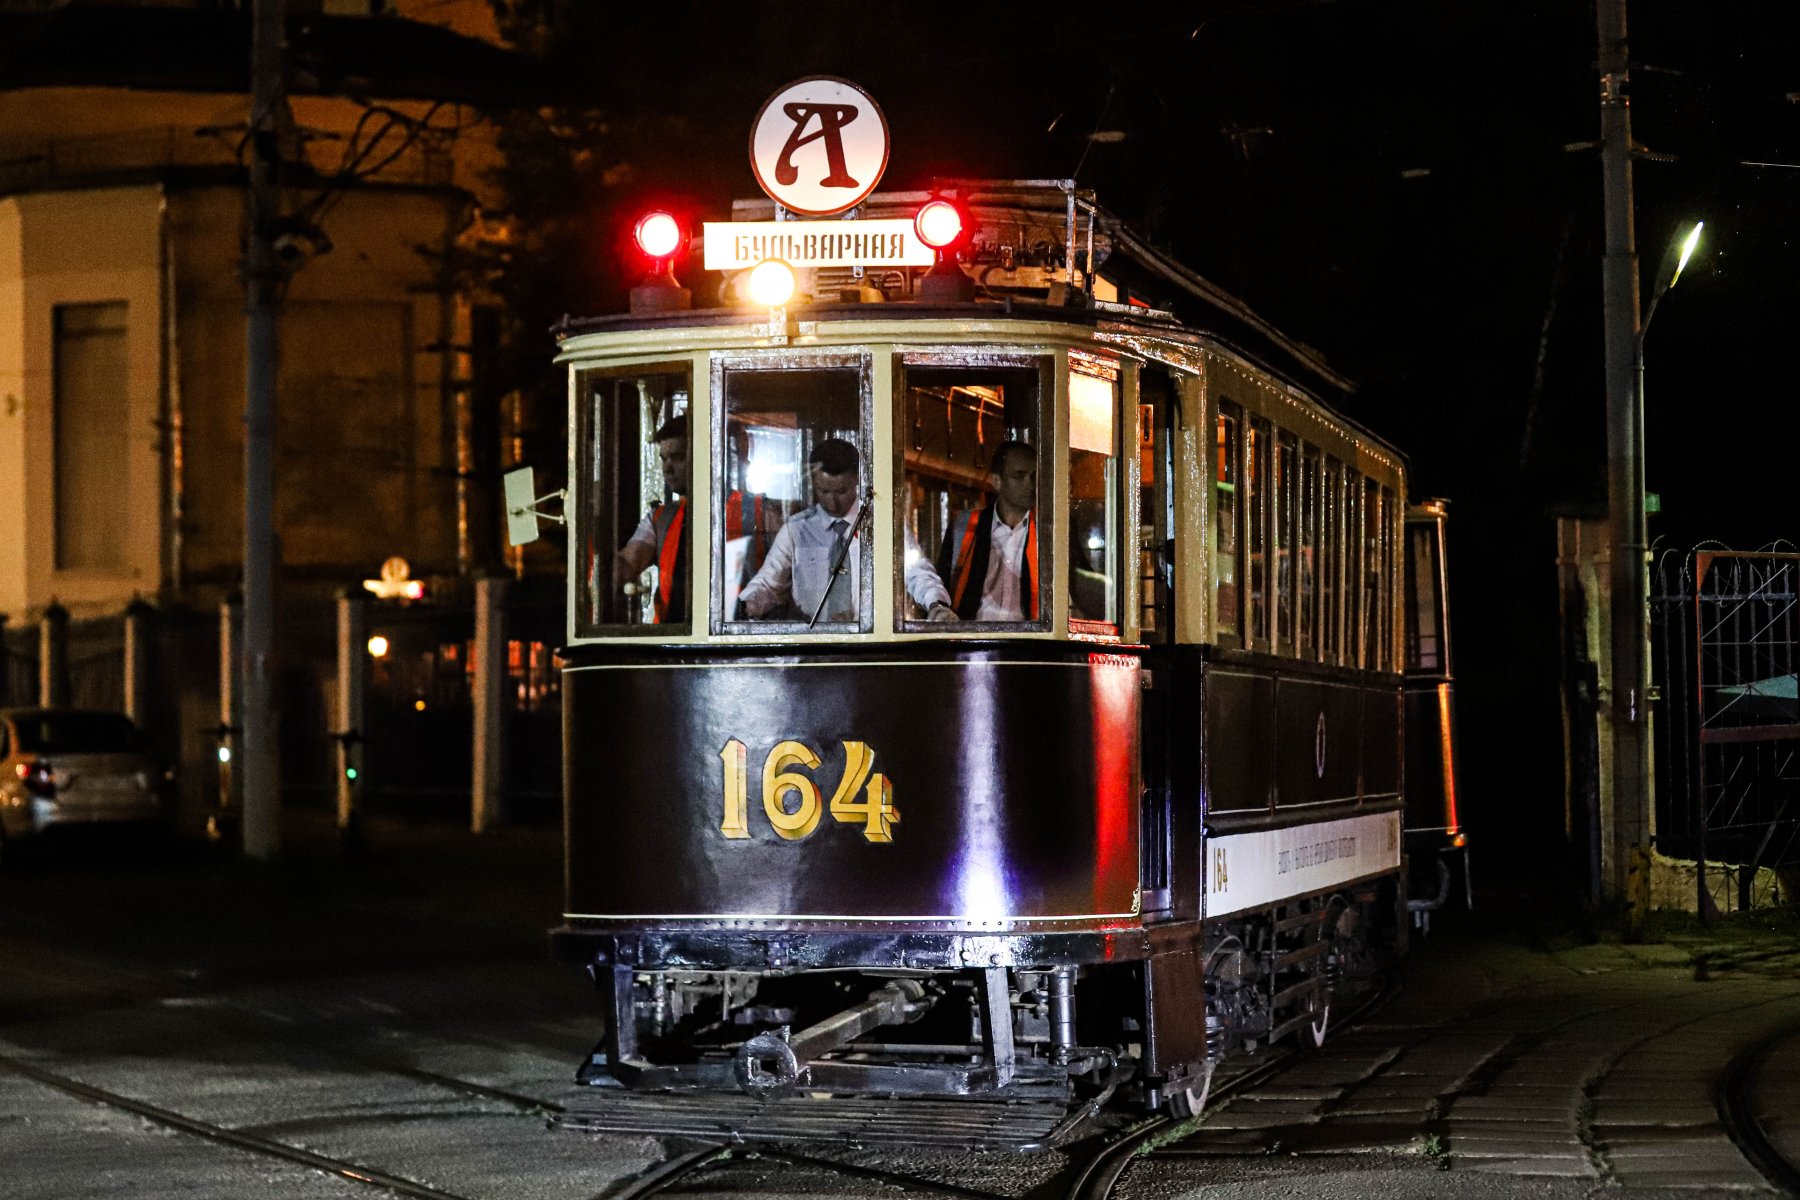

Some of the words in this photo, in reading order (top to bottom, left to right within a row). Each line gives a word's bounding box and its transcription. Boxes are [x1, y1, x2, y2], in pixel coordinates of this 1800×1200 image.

[775, 102, 859, 188] А
[735, 233, 905, 261] БУЛЬВАРНАЯ
[719, 736, 900, 843] 164
[1213, 847, 1228, 893] 164
